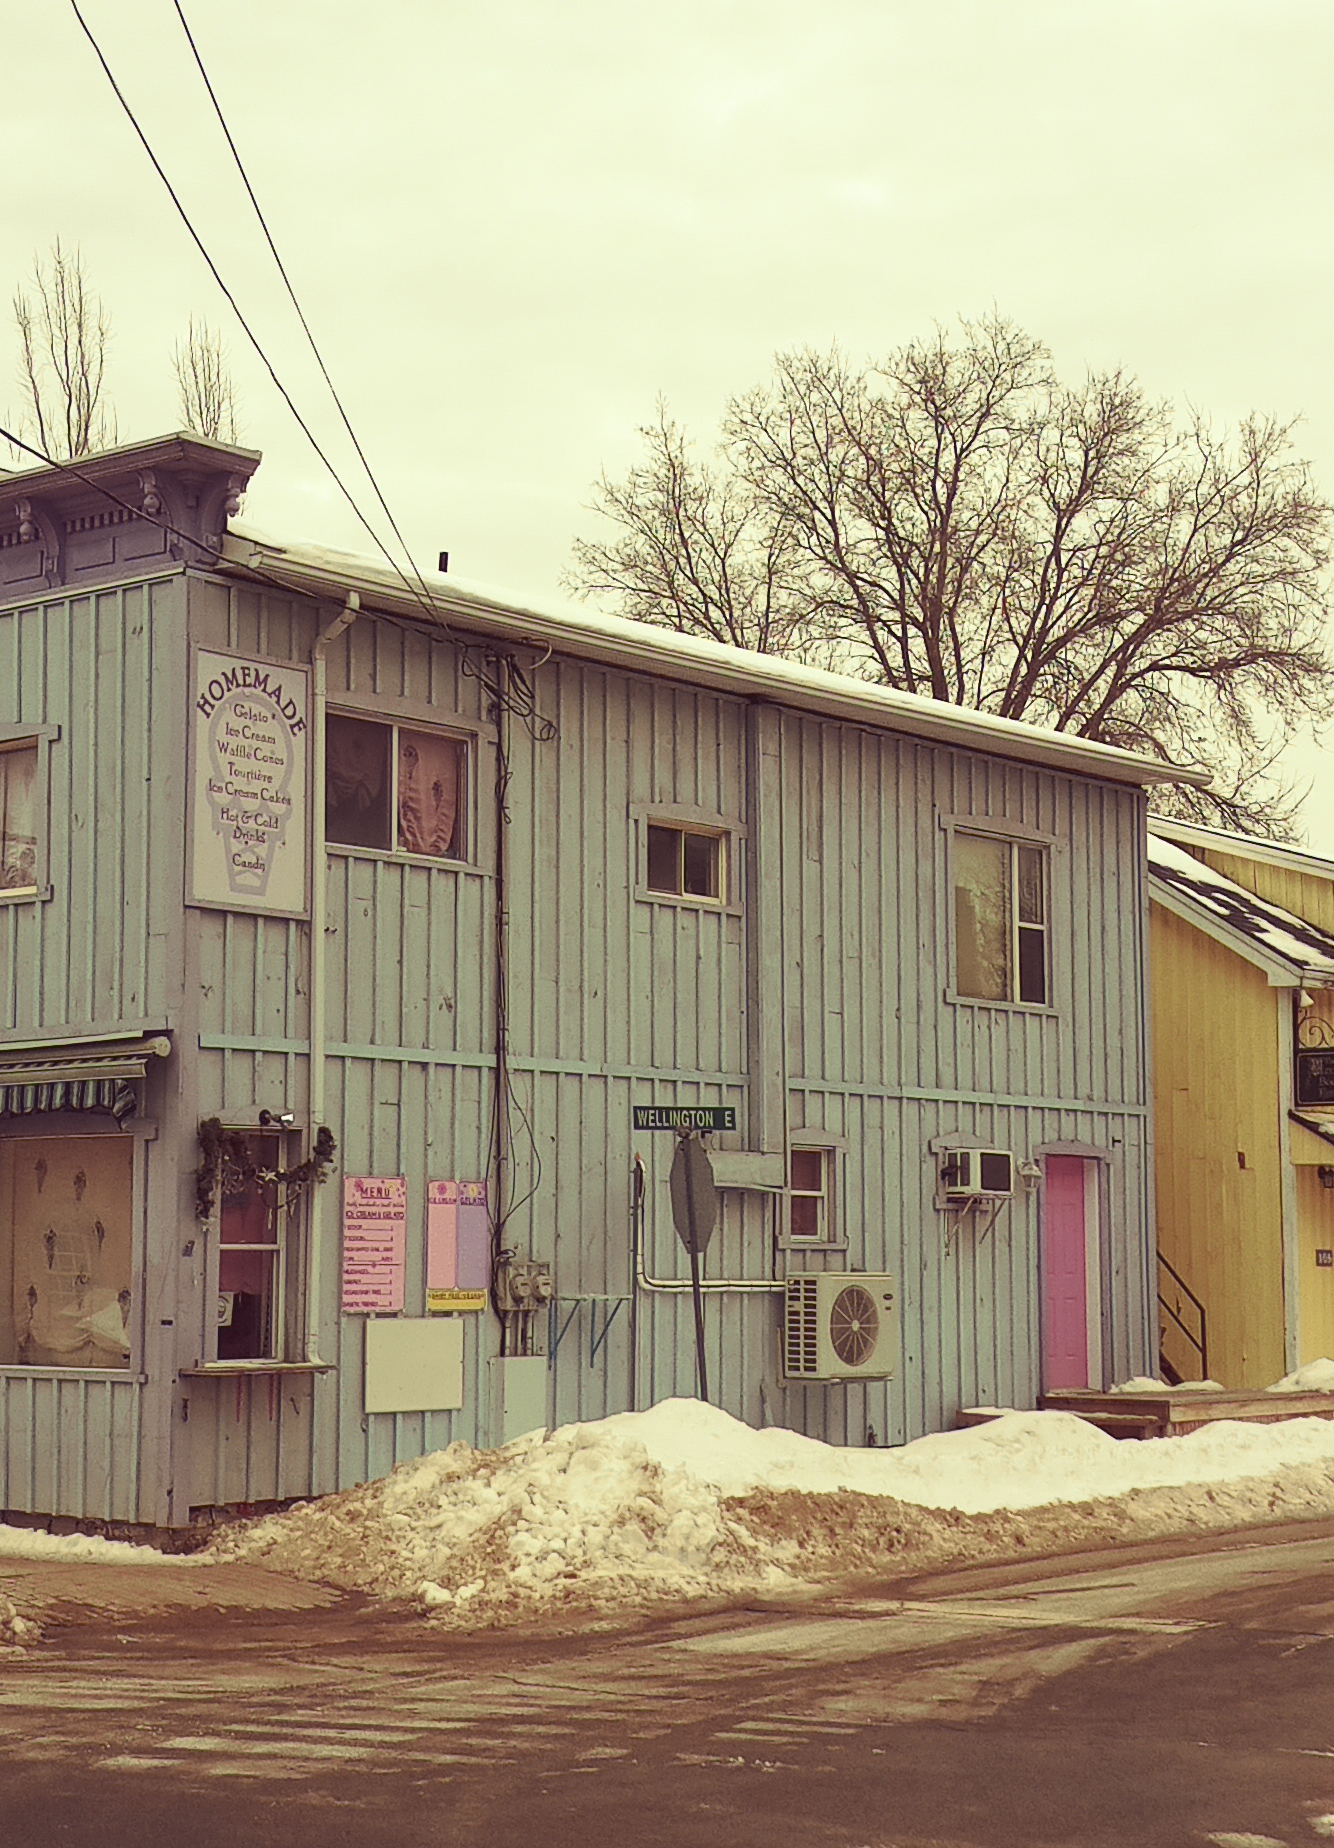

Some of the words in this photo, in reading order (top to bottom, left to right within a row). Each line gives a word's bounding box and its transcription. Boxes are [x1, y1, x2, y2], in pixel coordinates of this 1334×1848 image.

[196, 666, 307, 738] HOMEMADE
[233, 703, 268, 723] Gelato
[225, 722, 241, 737] Ice
[242, 724, 276, 745] Cream
[216, 739, 253, 760] Waffle
[253, 747, 285, 766] Cones
[208, 778, 224, 794] Ice
[224, 781, 259, 801] Cream
[260, 787, 292, 806] Cakes
[241, 810, 253, 825] &
[254, 812, 279, 830] Cold
[233, 827, 267, 844] Drinks
[232, 853, 266, 873] Candy
[636, 1109, 714, 1127] WELLINGTON
[724, 1110, 733, 1127] E
[360, 1186, 390, 1198] MENU
